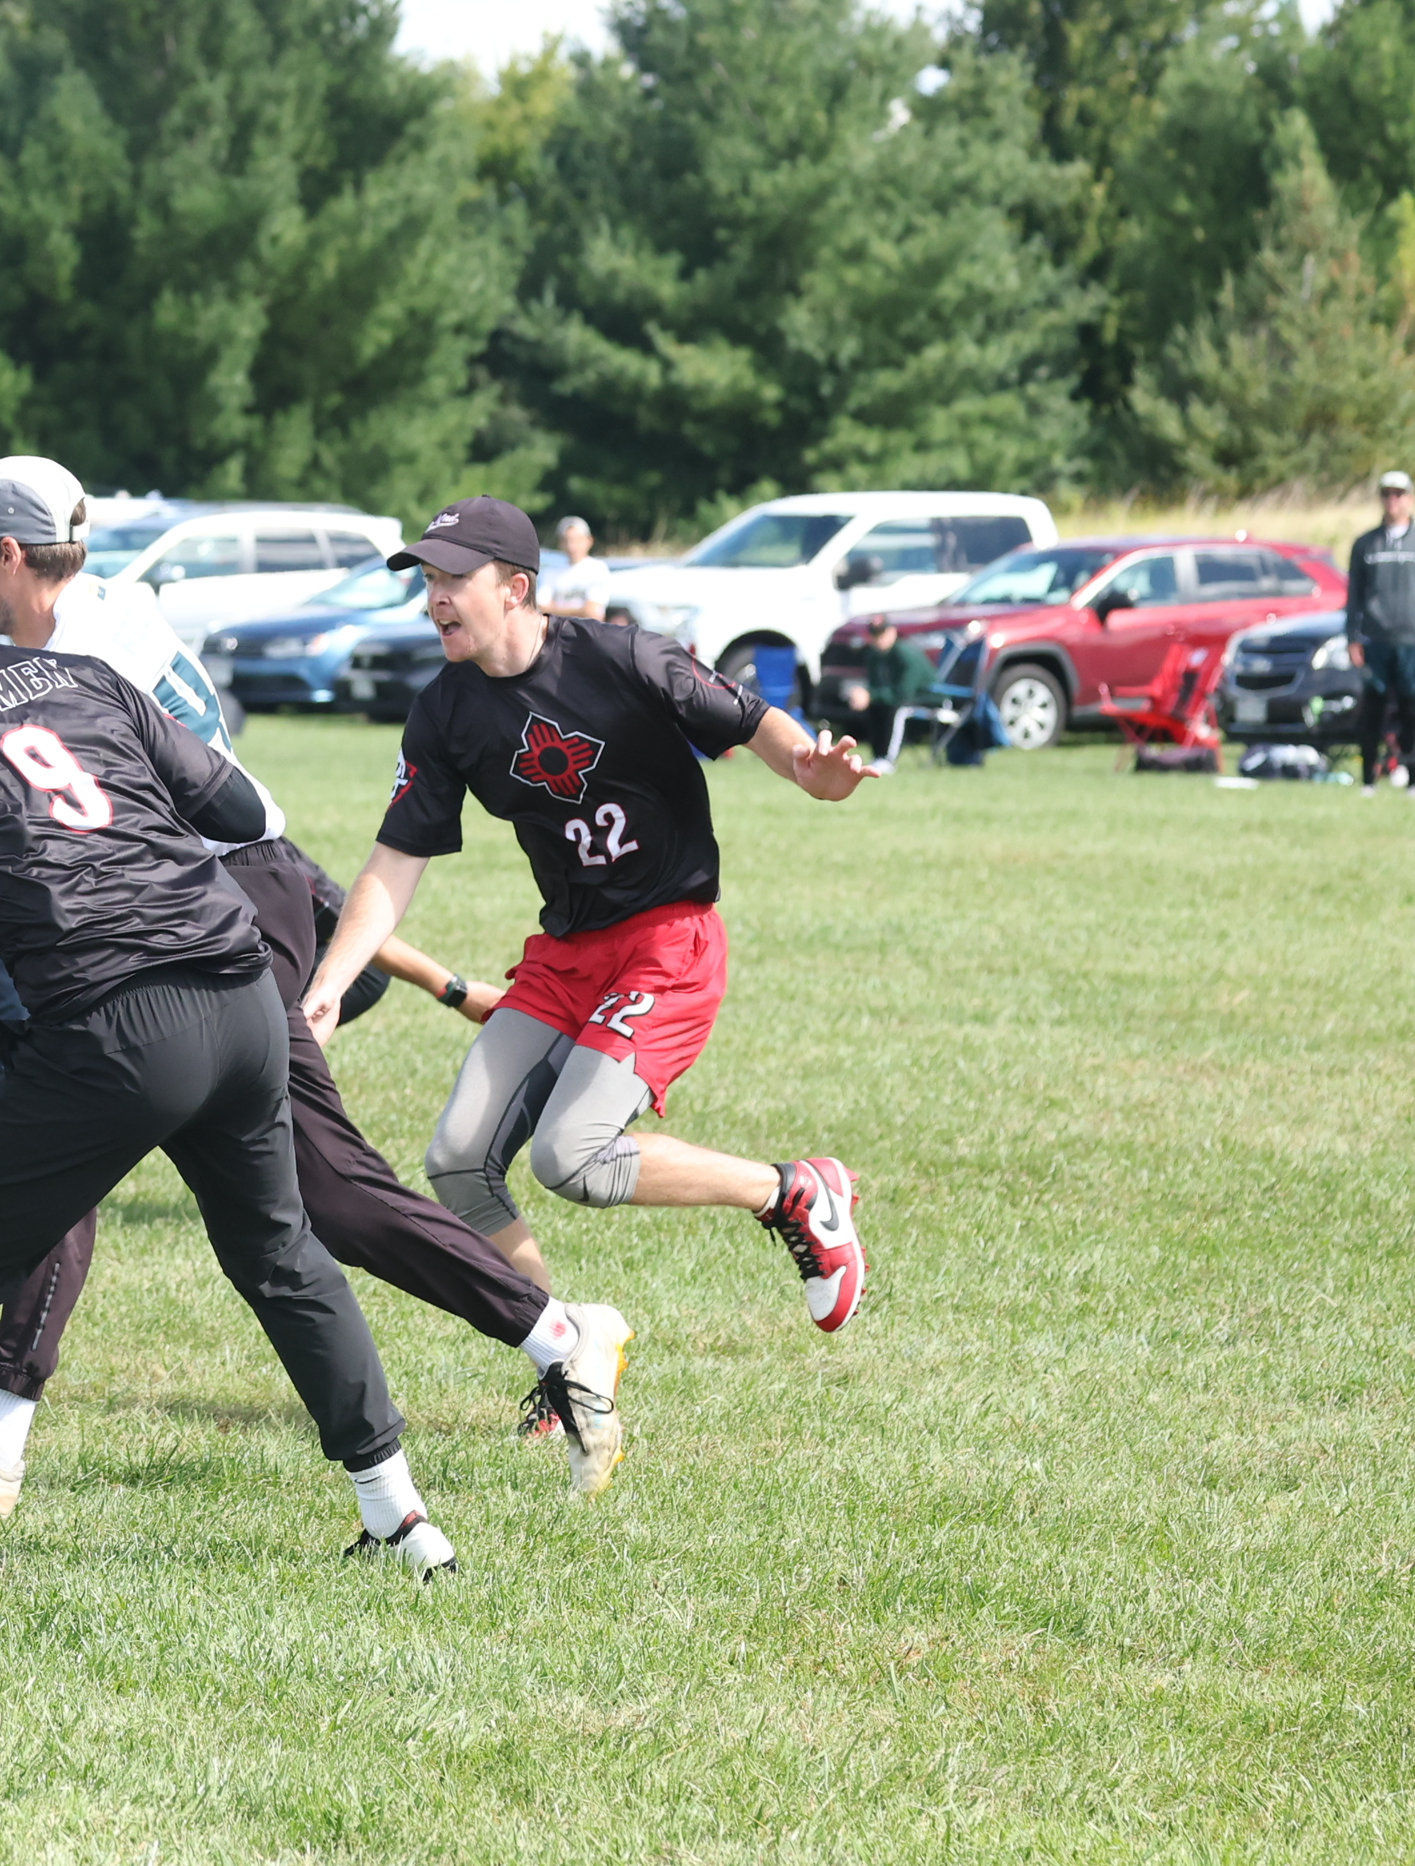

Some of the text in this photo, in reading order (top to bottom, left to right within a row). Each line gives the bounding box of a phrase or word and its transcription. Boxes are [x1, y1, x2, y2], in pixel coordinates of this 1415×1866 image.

[0, 723, 113, 834] 9
[564, 802, 639, 867] 22
[588, 991, 655, 1040] 22
